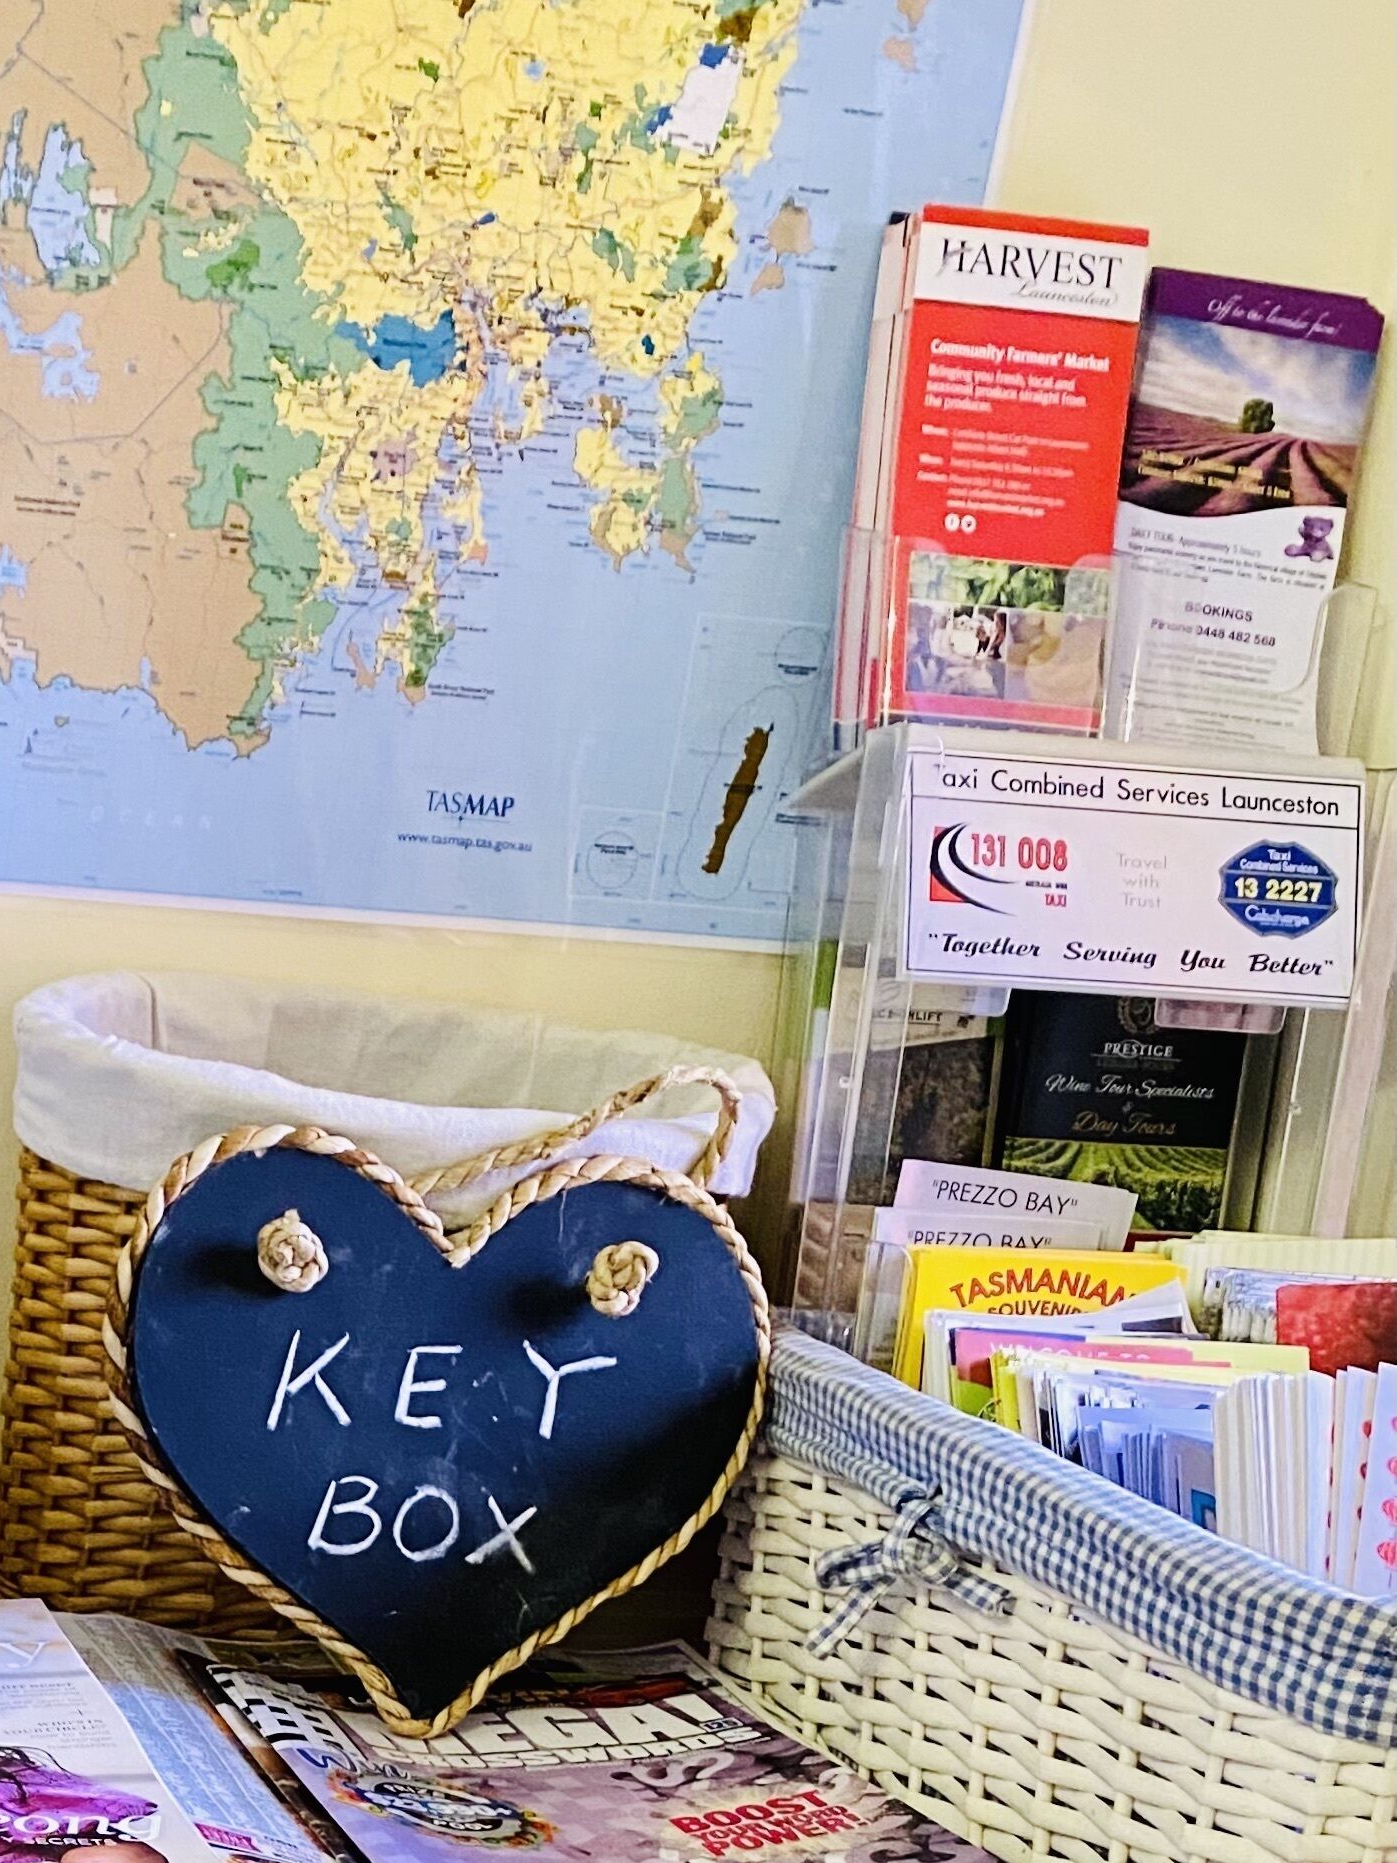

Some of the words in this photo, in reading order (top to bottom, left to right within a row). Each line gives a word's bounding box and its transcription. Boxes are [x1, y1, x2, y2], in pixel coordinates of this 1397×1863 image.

[936, 238, 1123, 289] HARVEST
[931, 338, 1006, 364] Community
[1064, 352, 1110, 373] Market
[1228, 629, 1252, 644] 482
[1254, 633, 1276, 648] 568
[934, 762, 978, 790] Taxi
[991, 769, 1104, 799] Combined
[1116, 779, 1209, 807] Services
[1222, 787, 1339, 817] Launceston
[426, 790, 515, 817] TASMAP
[398, 833, 532, 852] www.tasmap.tas.gov.au
[971, 832, 1006, 868] 131
[1018, 837, 1069, 873] 008
[1116, 852, 1170, 870] Travel
[1122, 873, 1161, 890] with
[1235, 877, 1258, 899] 13
[1265, 878, 1322, 903] 2227
[1121, 892, 1162, 909] Trust
[1063, 941, 1157, 969] Serving
[1180, 949, 1227, 972] You
[1104, 1041, 1174, 1059] PRESTIGE
[1045, 1073, 1091, 1093] Wine
[1095, 1074, 1133, 1096] Tour
[1134, 1079, 1214, 1099] Specialists
[1072, 1110, 1119, 1137] Day
[1122, 1112, 1177, 1136] Tours
[266, 1329, 618, 1440] KEY
[308, 1474, 538, 1575] BOX
[372, 1728, 764, 1770] CROSSWORDS
[669, 1789, 828, 1834] BOOST
[767, 1805, 848, 1827] WORD
[702, 1812, 868, 1857] POWER!
